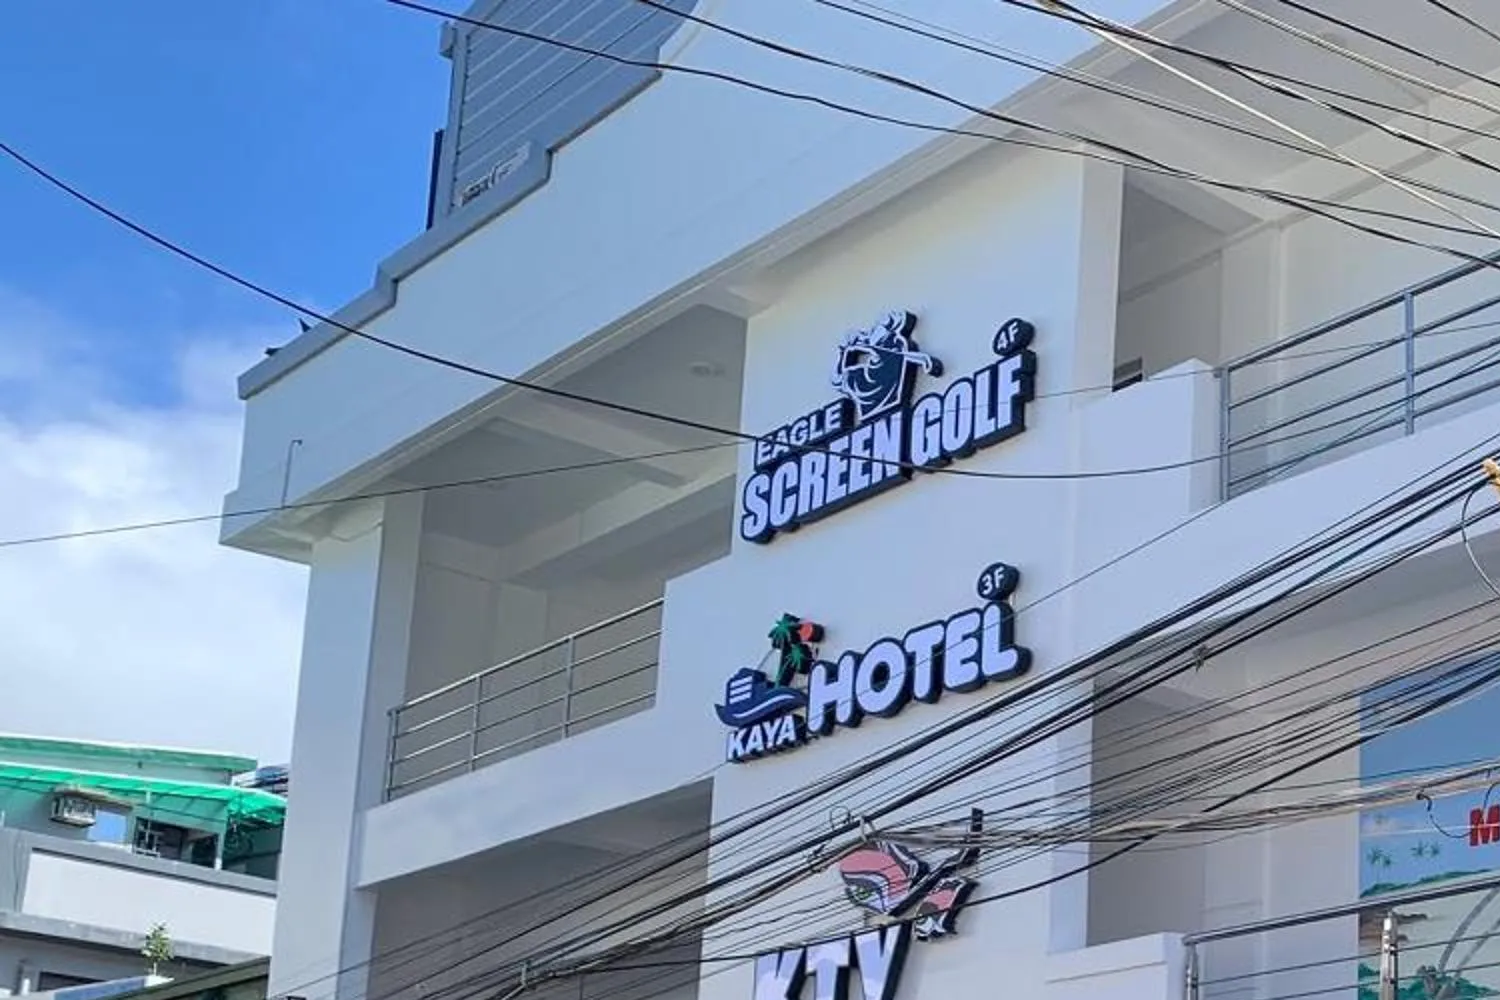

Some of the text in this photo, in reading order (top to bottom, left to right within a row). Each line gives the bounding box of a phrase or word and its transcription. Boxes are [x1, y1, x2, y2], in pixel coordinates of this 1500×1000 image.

[997, 322, 1021, 350] 4F
[743, 354, 1025, 539] SCREEN GOLF
[756, 403, 843, 465] EAGLE
[981, 566, 1005, 597] 3F
[808, 602, 1019, 732] HOTEL
[727, 715, 797, 760] KAYA
